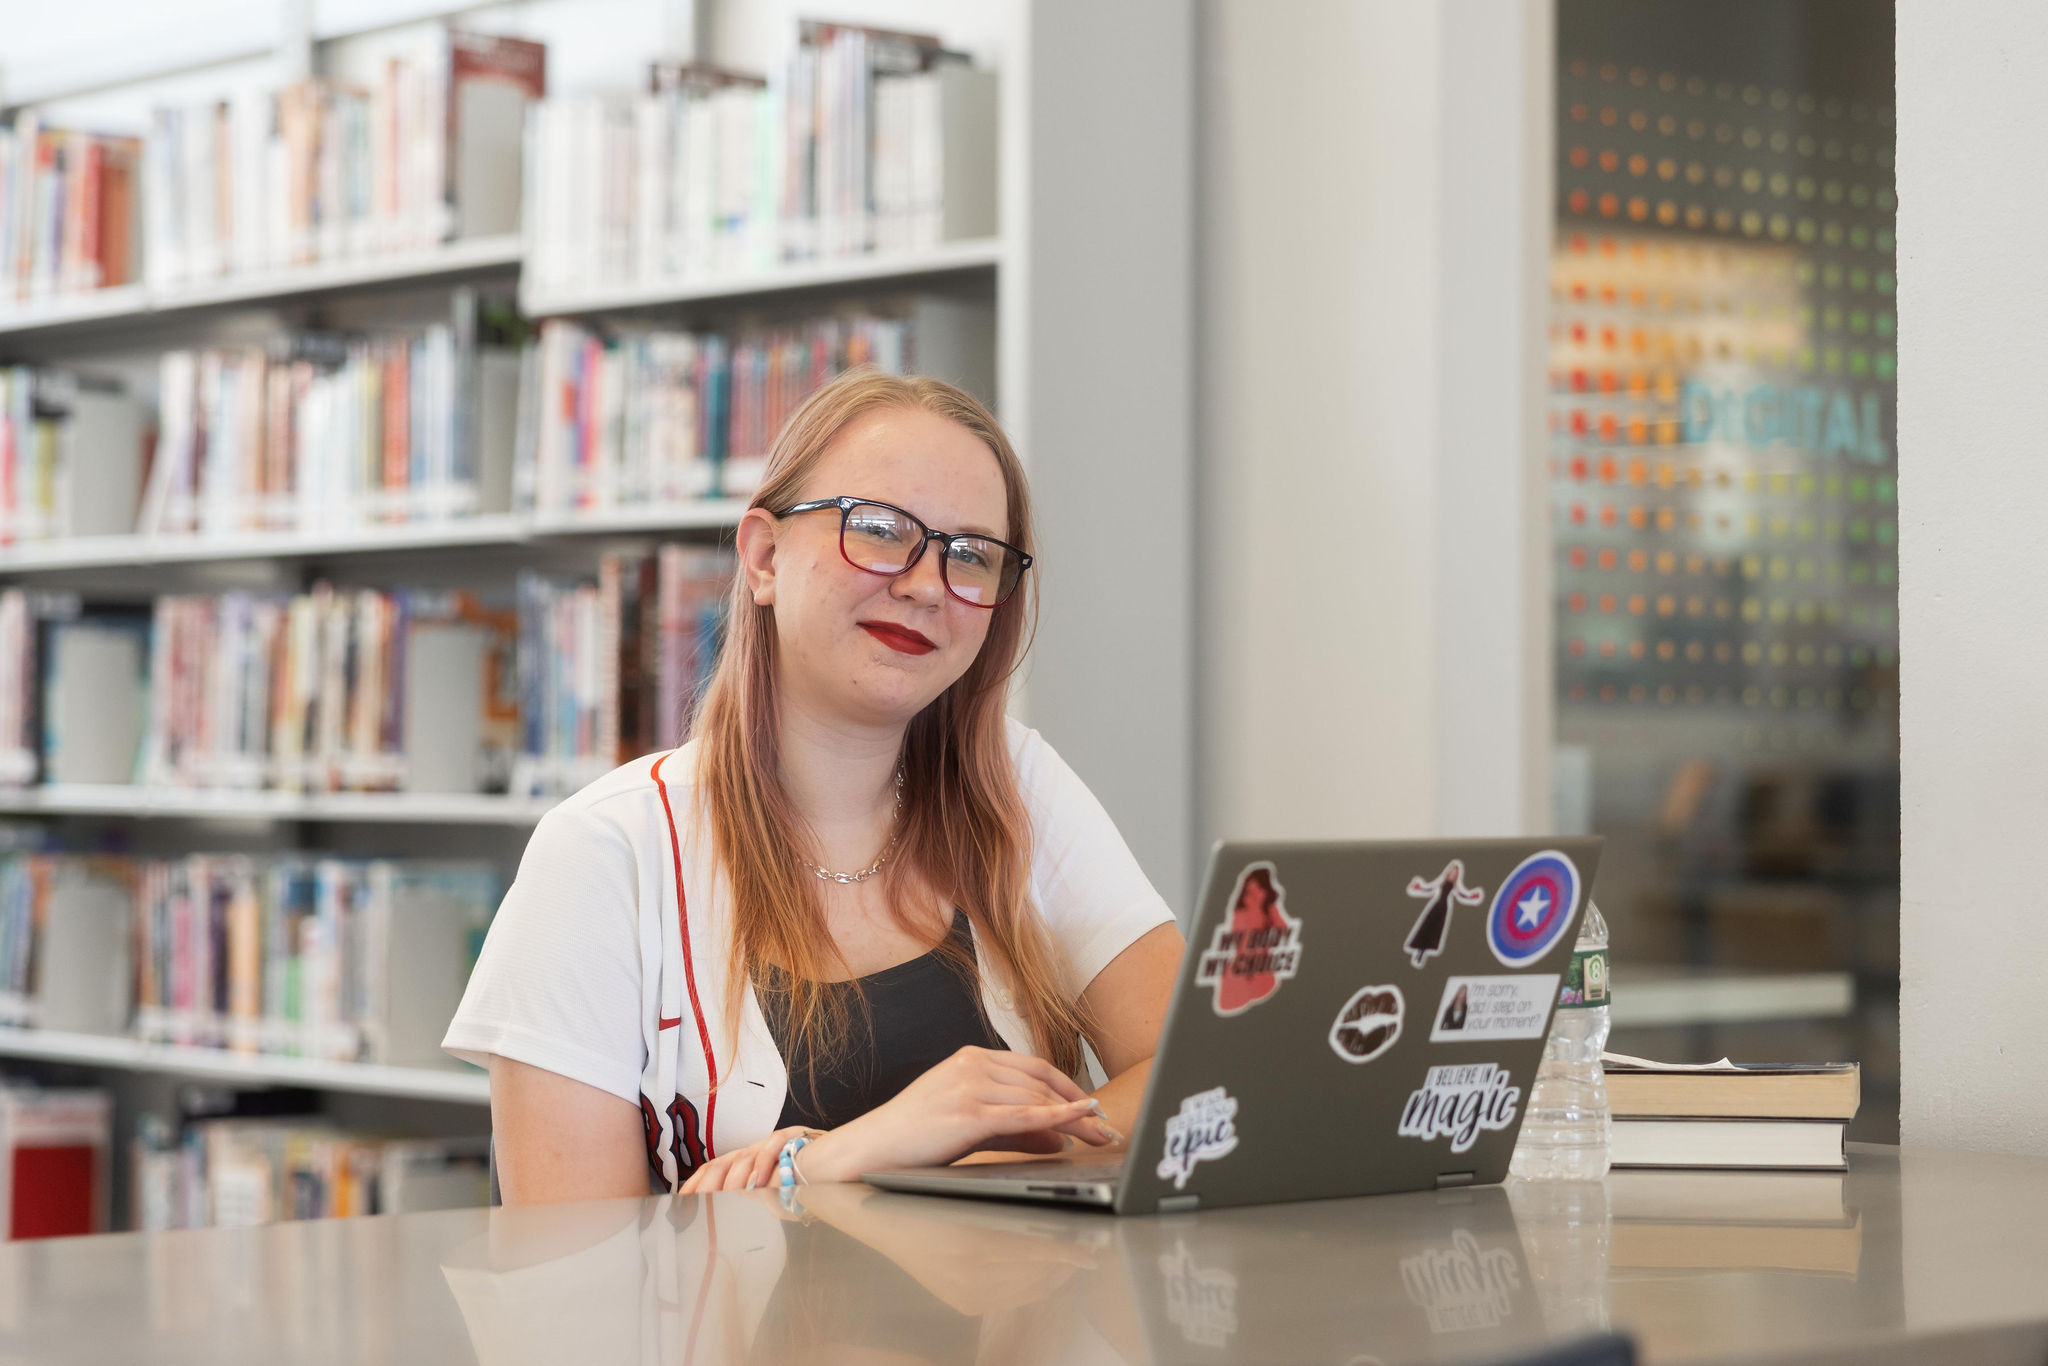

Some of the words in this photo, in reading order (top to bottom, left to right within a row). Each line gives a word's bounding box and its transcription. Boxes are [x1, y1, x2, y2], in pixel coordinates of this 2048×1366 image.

[1683, 379, 1887, 464] DIGITAL
[1230, 949, 1296, 976] CHOICE
[1435, 1066, 1479, 1086] BELIEVE
[1479, 1066, 1493, 1083] IN
